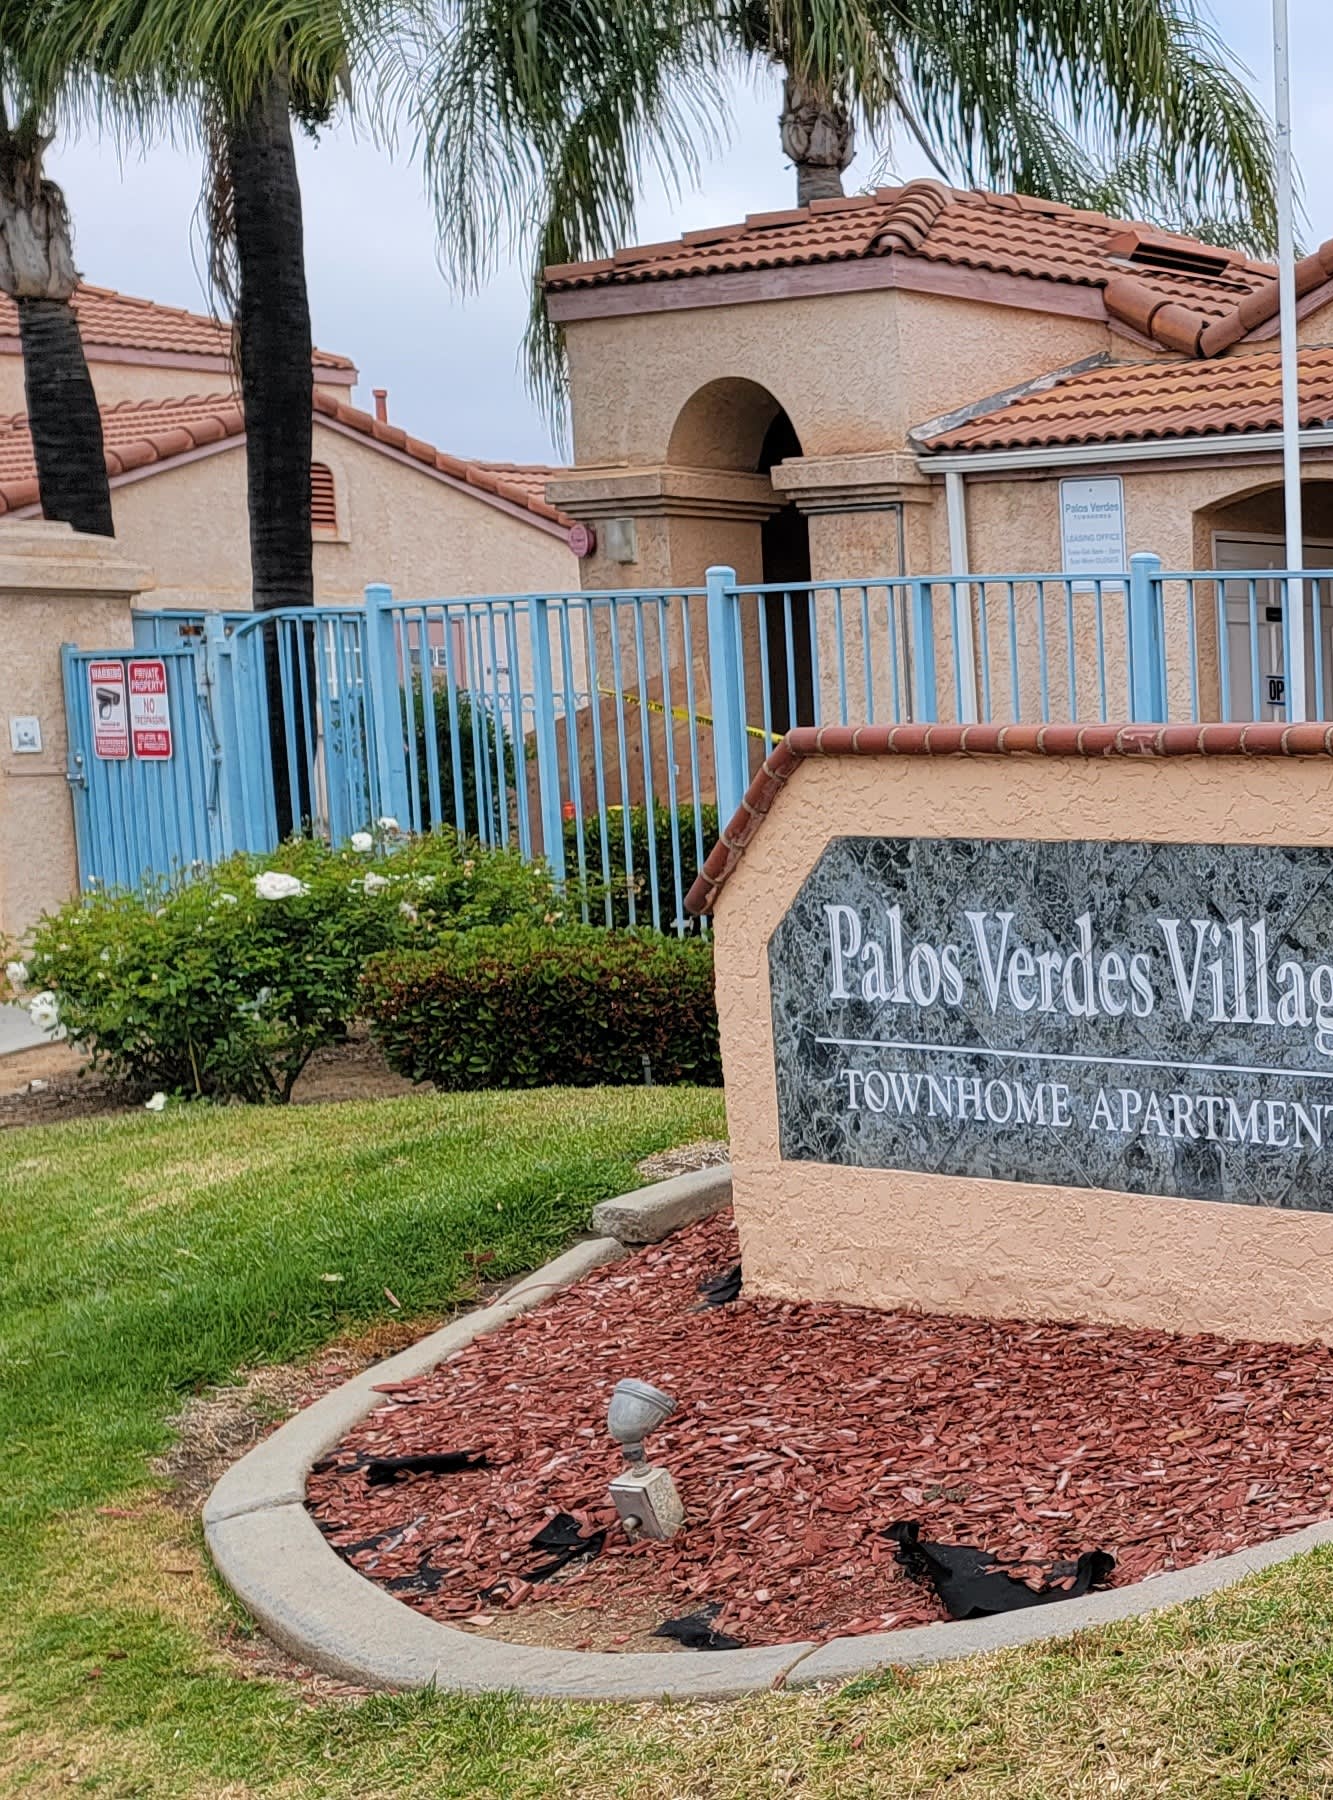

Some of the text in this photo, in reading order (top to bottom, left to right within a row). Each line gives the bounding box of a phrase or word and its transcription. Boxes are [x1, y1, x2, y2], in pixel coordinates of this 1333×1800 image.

[1065, 502, 1119, 513] Palos Verdes
[134, 667, 160, 680] PRIVATE
[131, 680, 163, 692] PROPERTY
[1269, 679, 1285, 701] OP
[143, 698, 155, 713] NO
[823, 903, 963, 1006] Palos
[964, 911, 1153, 1018] Verdes
[840, 1068, 1072, 1127] TOWNHOME
